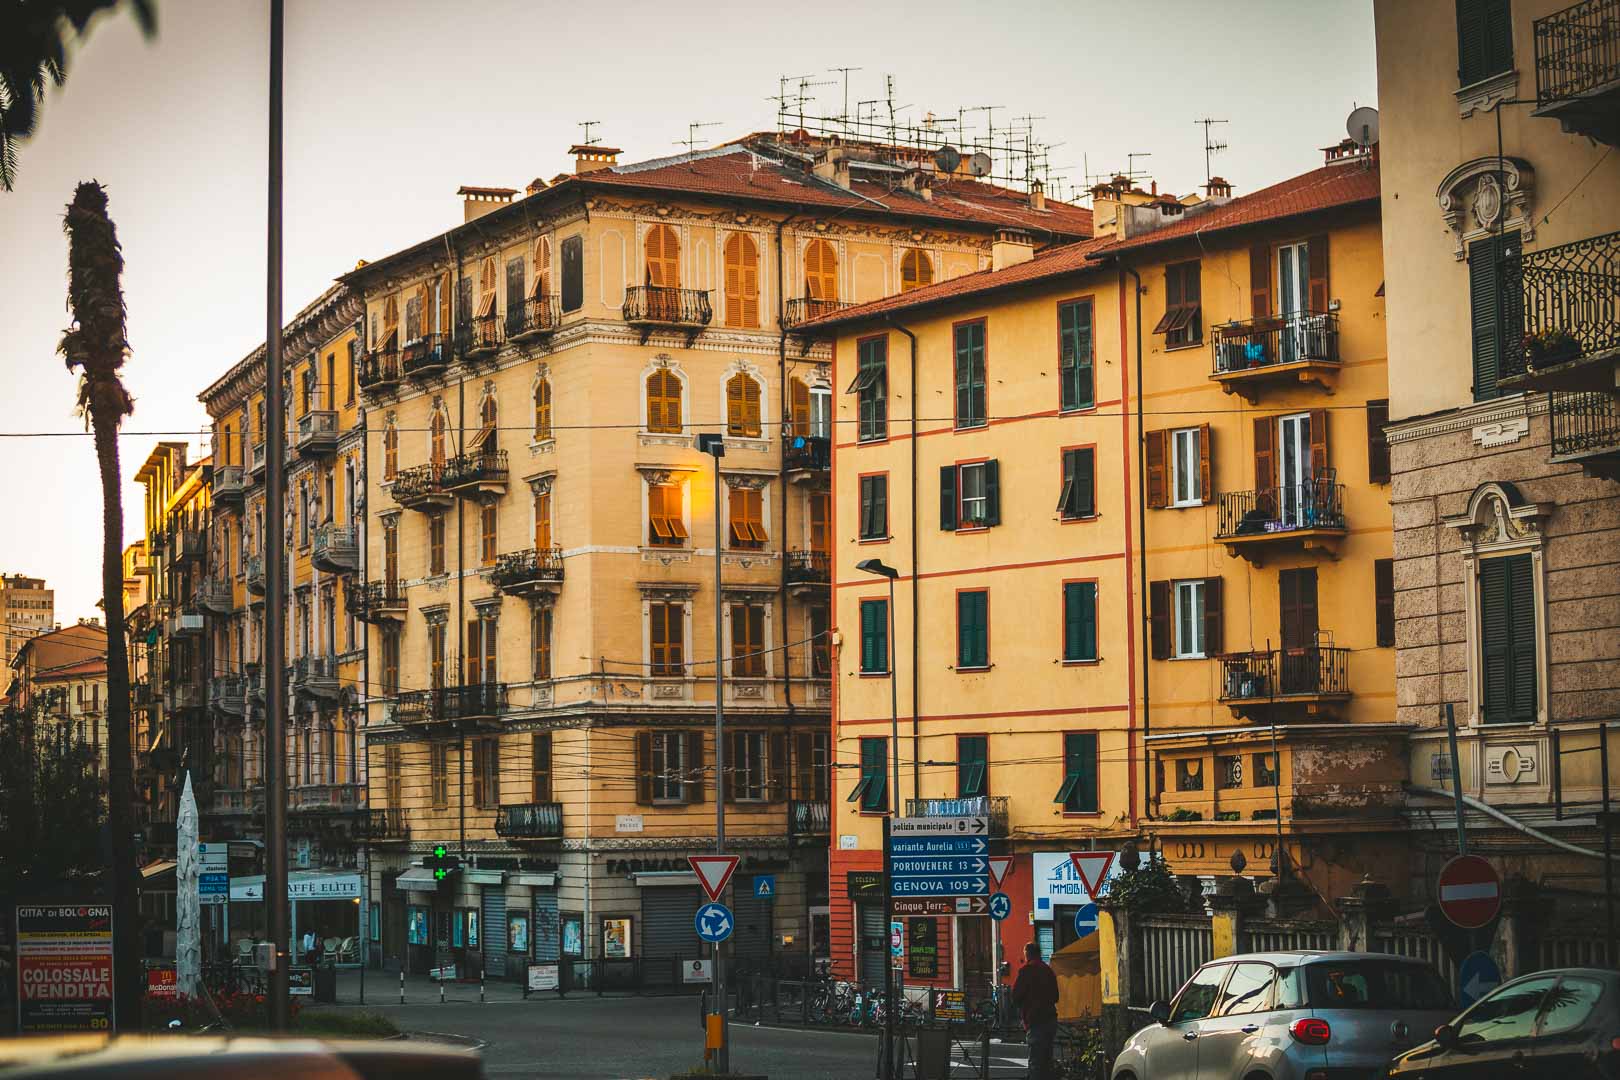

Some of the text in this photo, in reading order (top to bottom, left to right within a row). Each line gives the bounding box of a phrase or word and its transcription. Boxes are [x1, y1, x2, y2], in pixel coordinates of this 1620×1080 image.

[893, 822, 953, 832] polizia municipale
[893, 842, 924, 852] variante
[926, 842, 953, 851] Aurelia
[893, 861, 968, 871] PORTOVENERE 13
[288, 882, 316, 892] AFFÈ
[894, 881, 969, 891] GENOVA 109
[894, 901, 923, 912] Cinque
[59, 907, 109, 917] BOLOGNA
[23, 967, 110, 983] COLOSSALE
[23, 983, 111, 998] VENDITA
